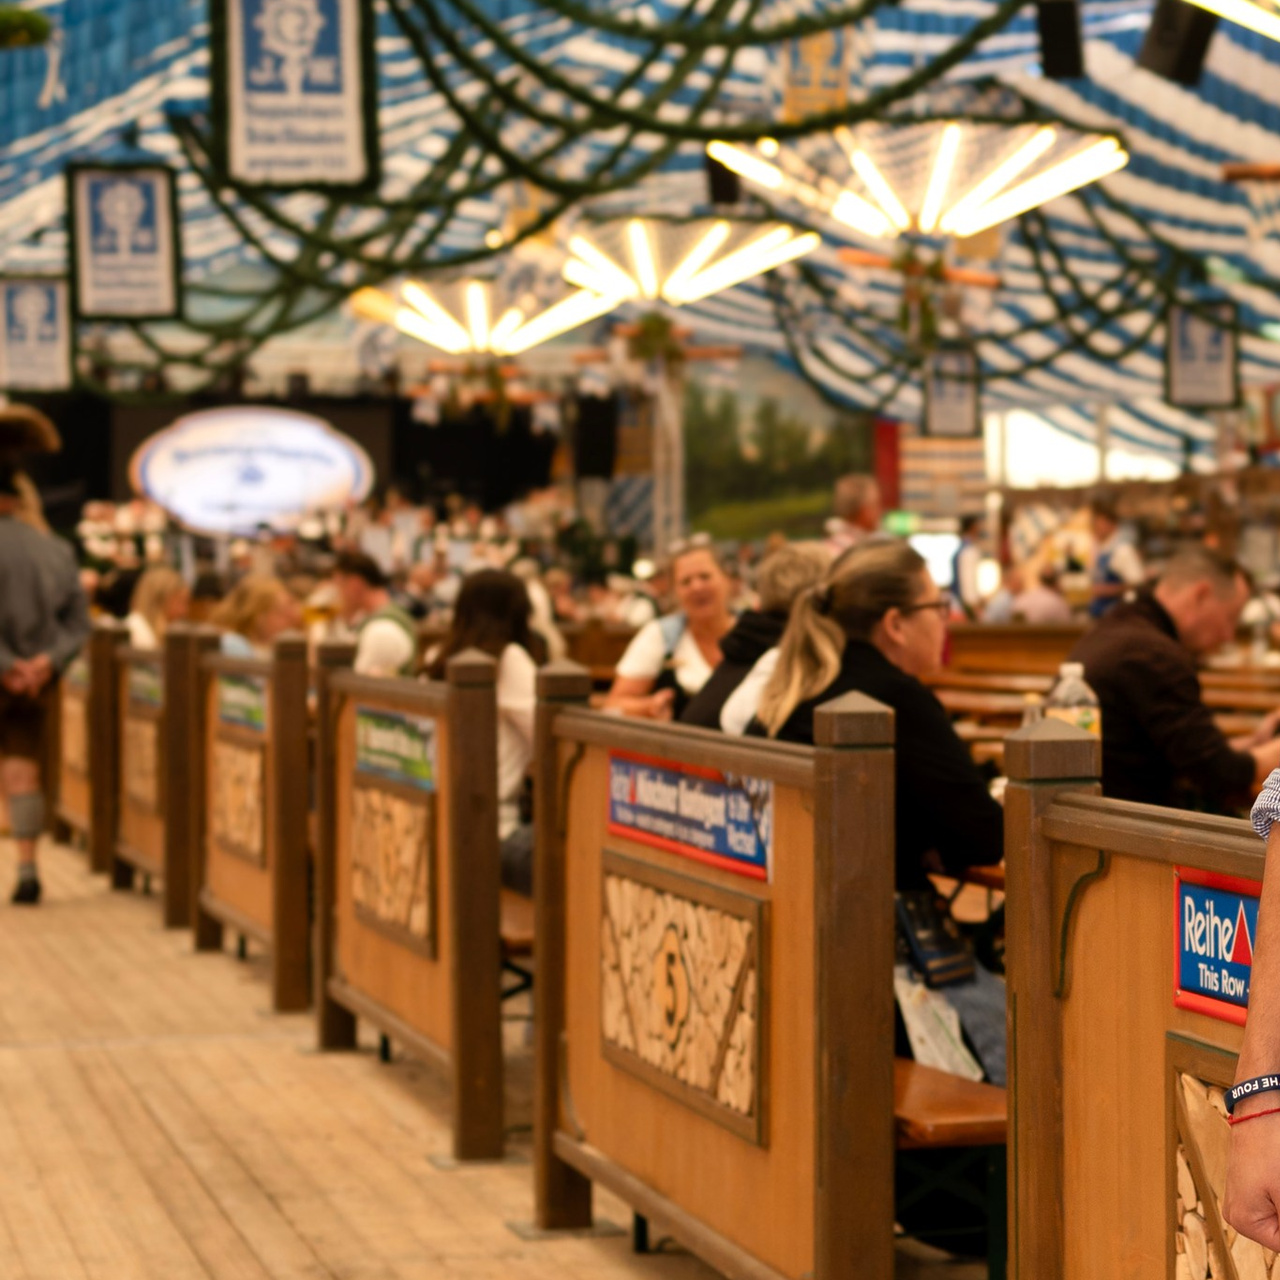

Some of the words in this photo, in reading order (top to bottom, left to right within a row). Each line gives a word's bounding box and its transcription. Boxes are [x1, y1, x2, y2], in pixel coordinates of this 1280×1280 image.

[1184, 895, 1234, 963] Reihe
[1198, 963, 1219, 992] This
[1221, 969, 1245, 997] Row
[1231, 1080, 1260, 1099] FOUR
